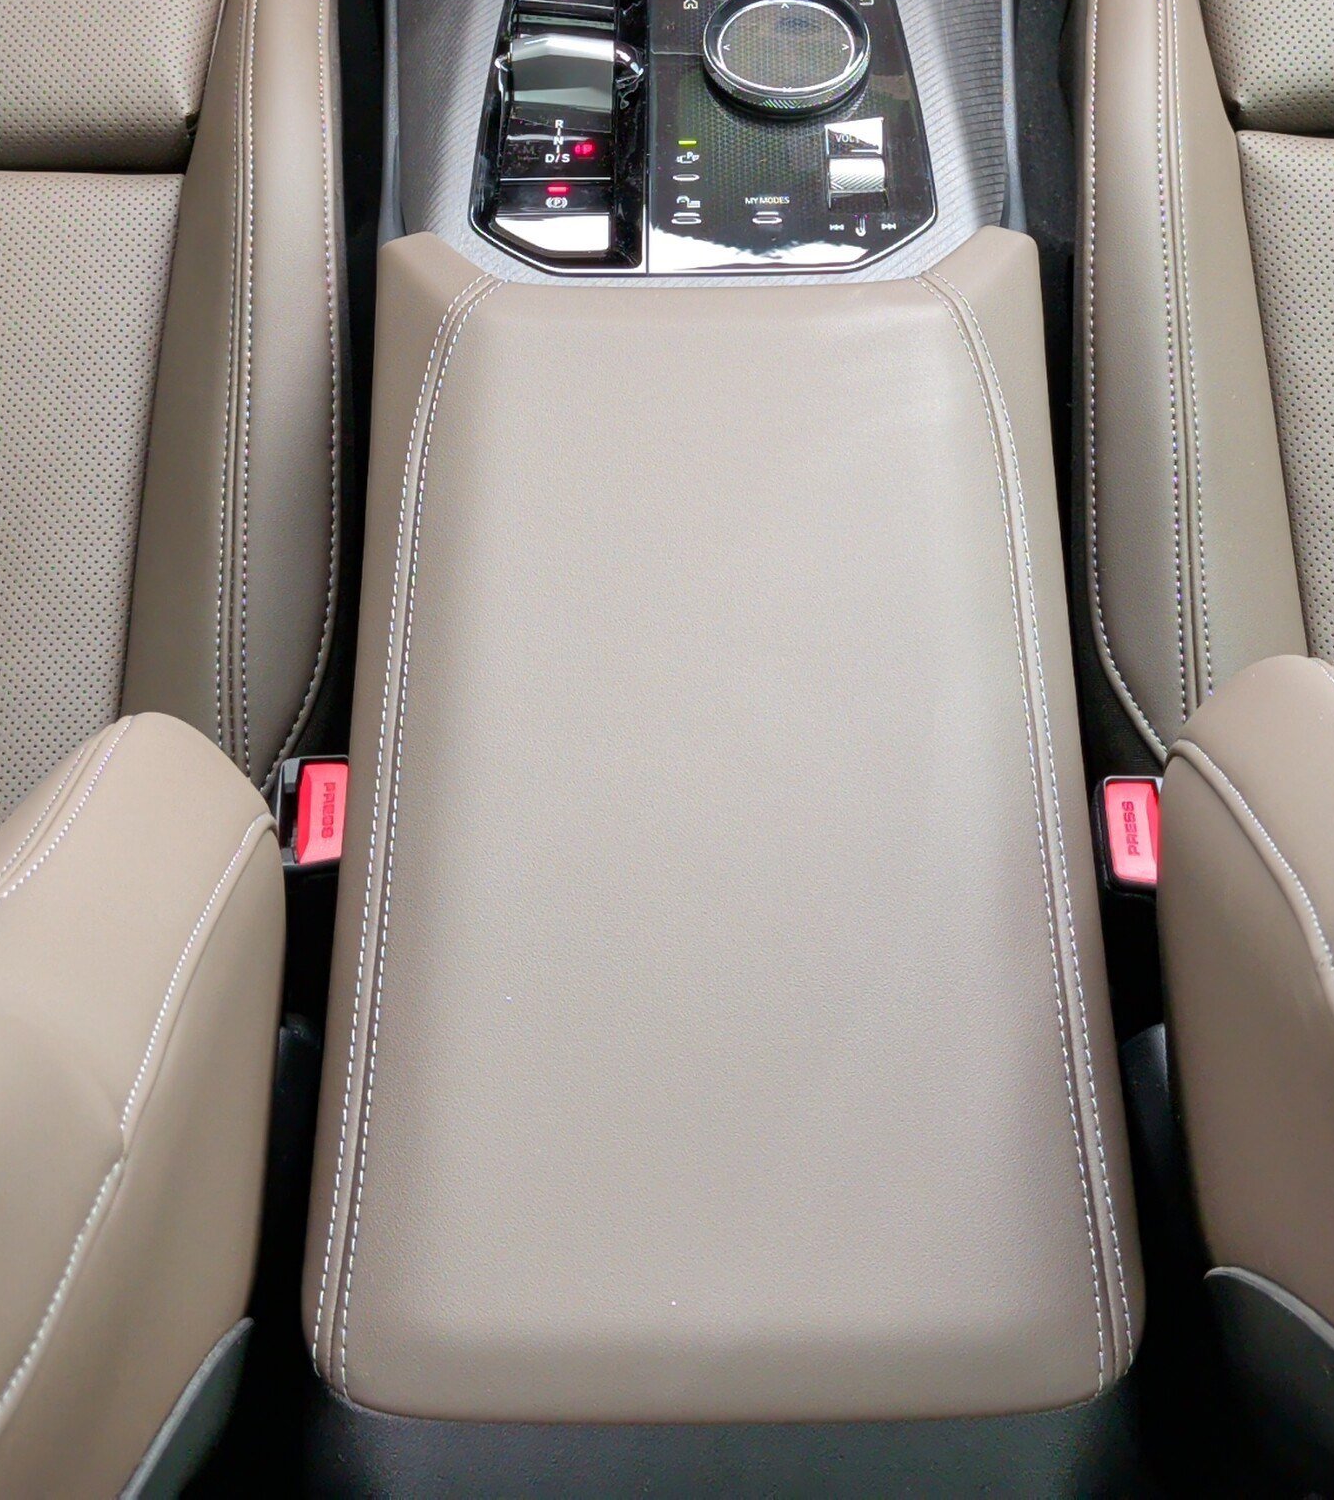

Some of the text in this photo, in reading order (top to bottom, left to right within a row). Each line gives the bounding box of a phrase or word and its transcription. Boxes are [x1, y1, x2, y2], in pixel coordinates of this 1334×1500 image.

[554, 120, 564, 128] R
[553, 136, 564, 145] N
[545, 154, 571, 163] D/S
[759, 196, 790, 204] MODES
[1121, 801, 1140, 856] PRESS
